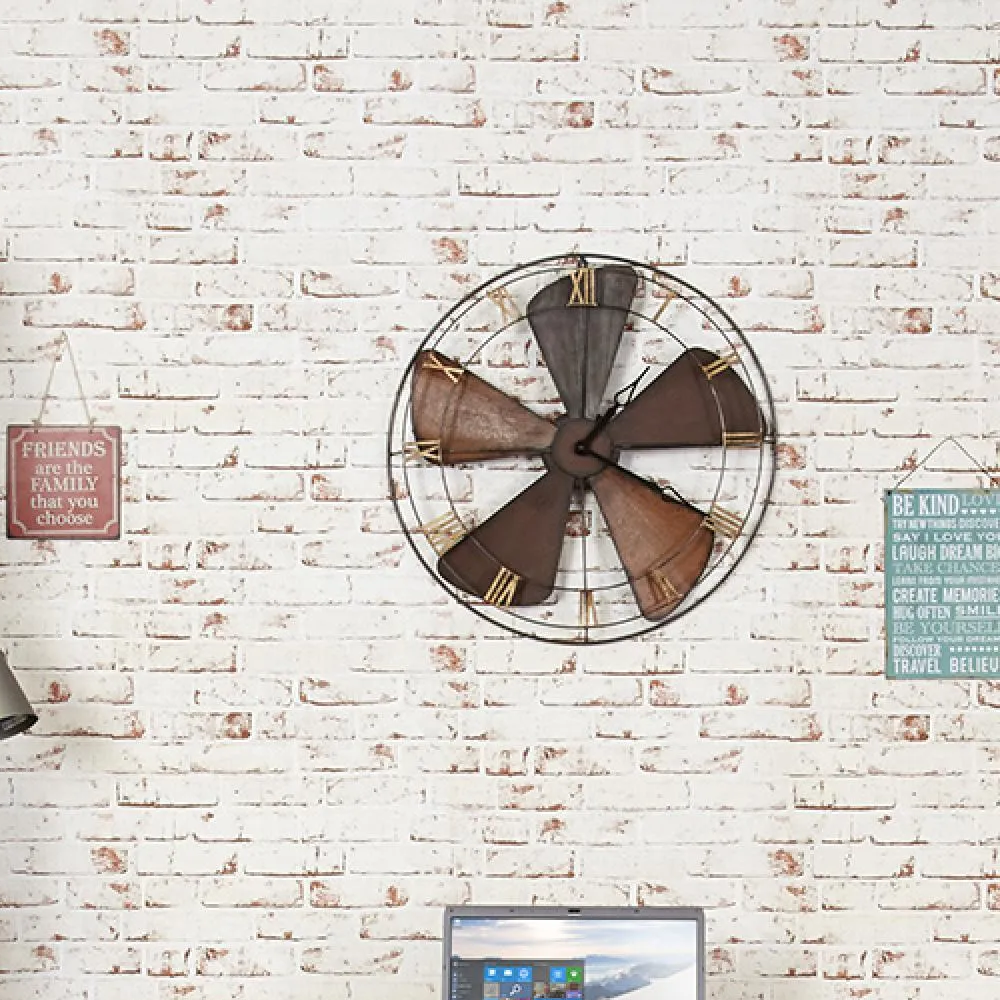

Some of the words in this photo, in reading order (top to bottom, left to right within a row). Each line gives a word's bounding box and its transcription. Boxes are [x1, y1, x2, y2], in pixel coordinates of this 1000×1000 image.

[567, 268, 598, 306] XII
[22, 441, 106, 458] FRIENDS
[34, 463, 61, 475] are
[65, 460, 93, 475] the
[30, 477, 99, 492] FAMILY
[30, 494, 63, 508] that
[67, 497, 98, 514] you
[893, 494, 914, 516] BE
[919, 494, 959, 516] KIND
[36, 510, 93, 525] choose
[893, 532, 920, 542] SAY
[934, 532, 972, 542] LOVE
[976, 532, 1000, 542] YO
[892, 544, 937, 560] LAUGH
[940, 544, 983, 560] DREAM
[893, 587, 938, 602] CREATE
[917, 605, 951, 619] OFTEN
[893, 621, 915, 635] BE
[920, 621, 1000, 635] YOURSEL
[893, 657, 942, 674] TRAVEL
